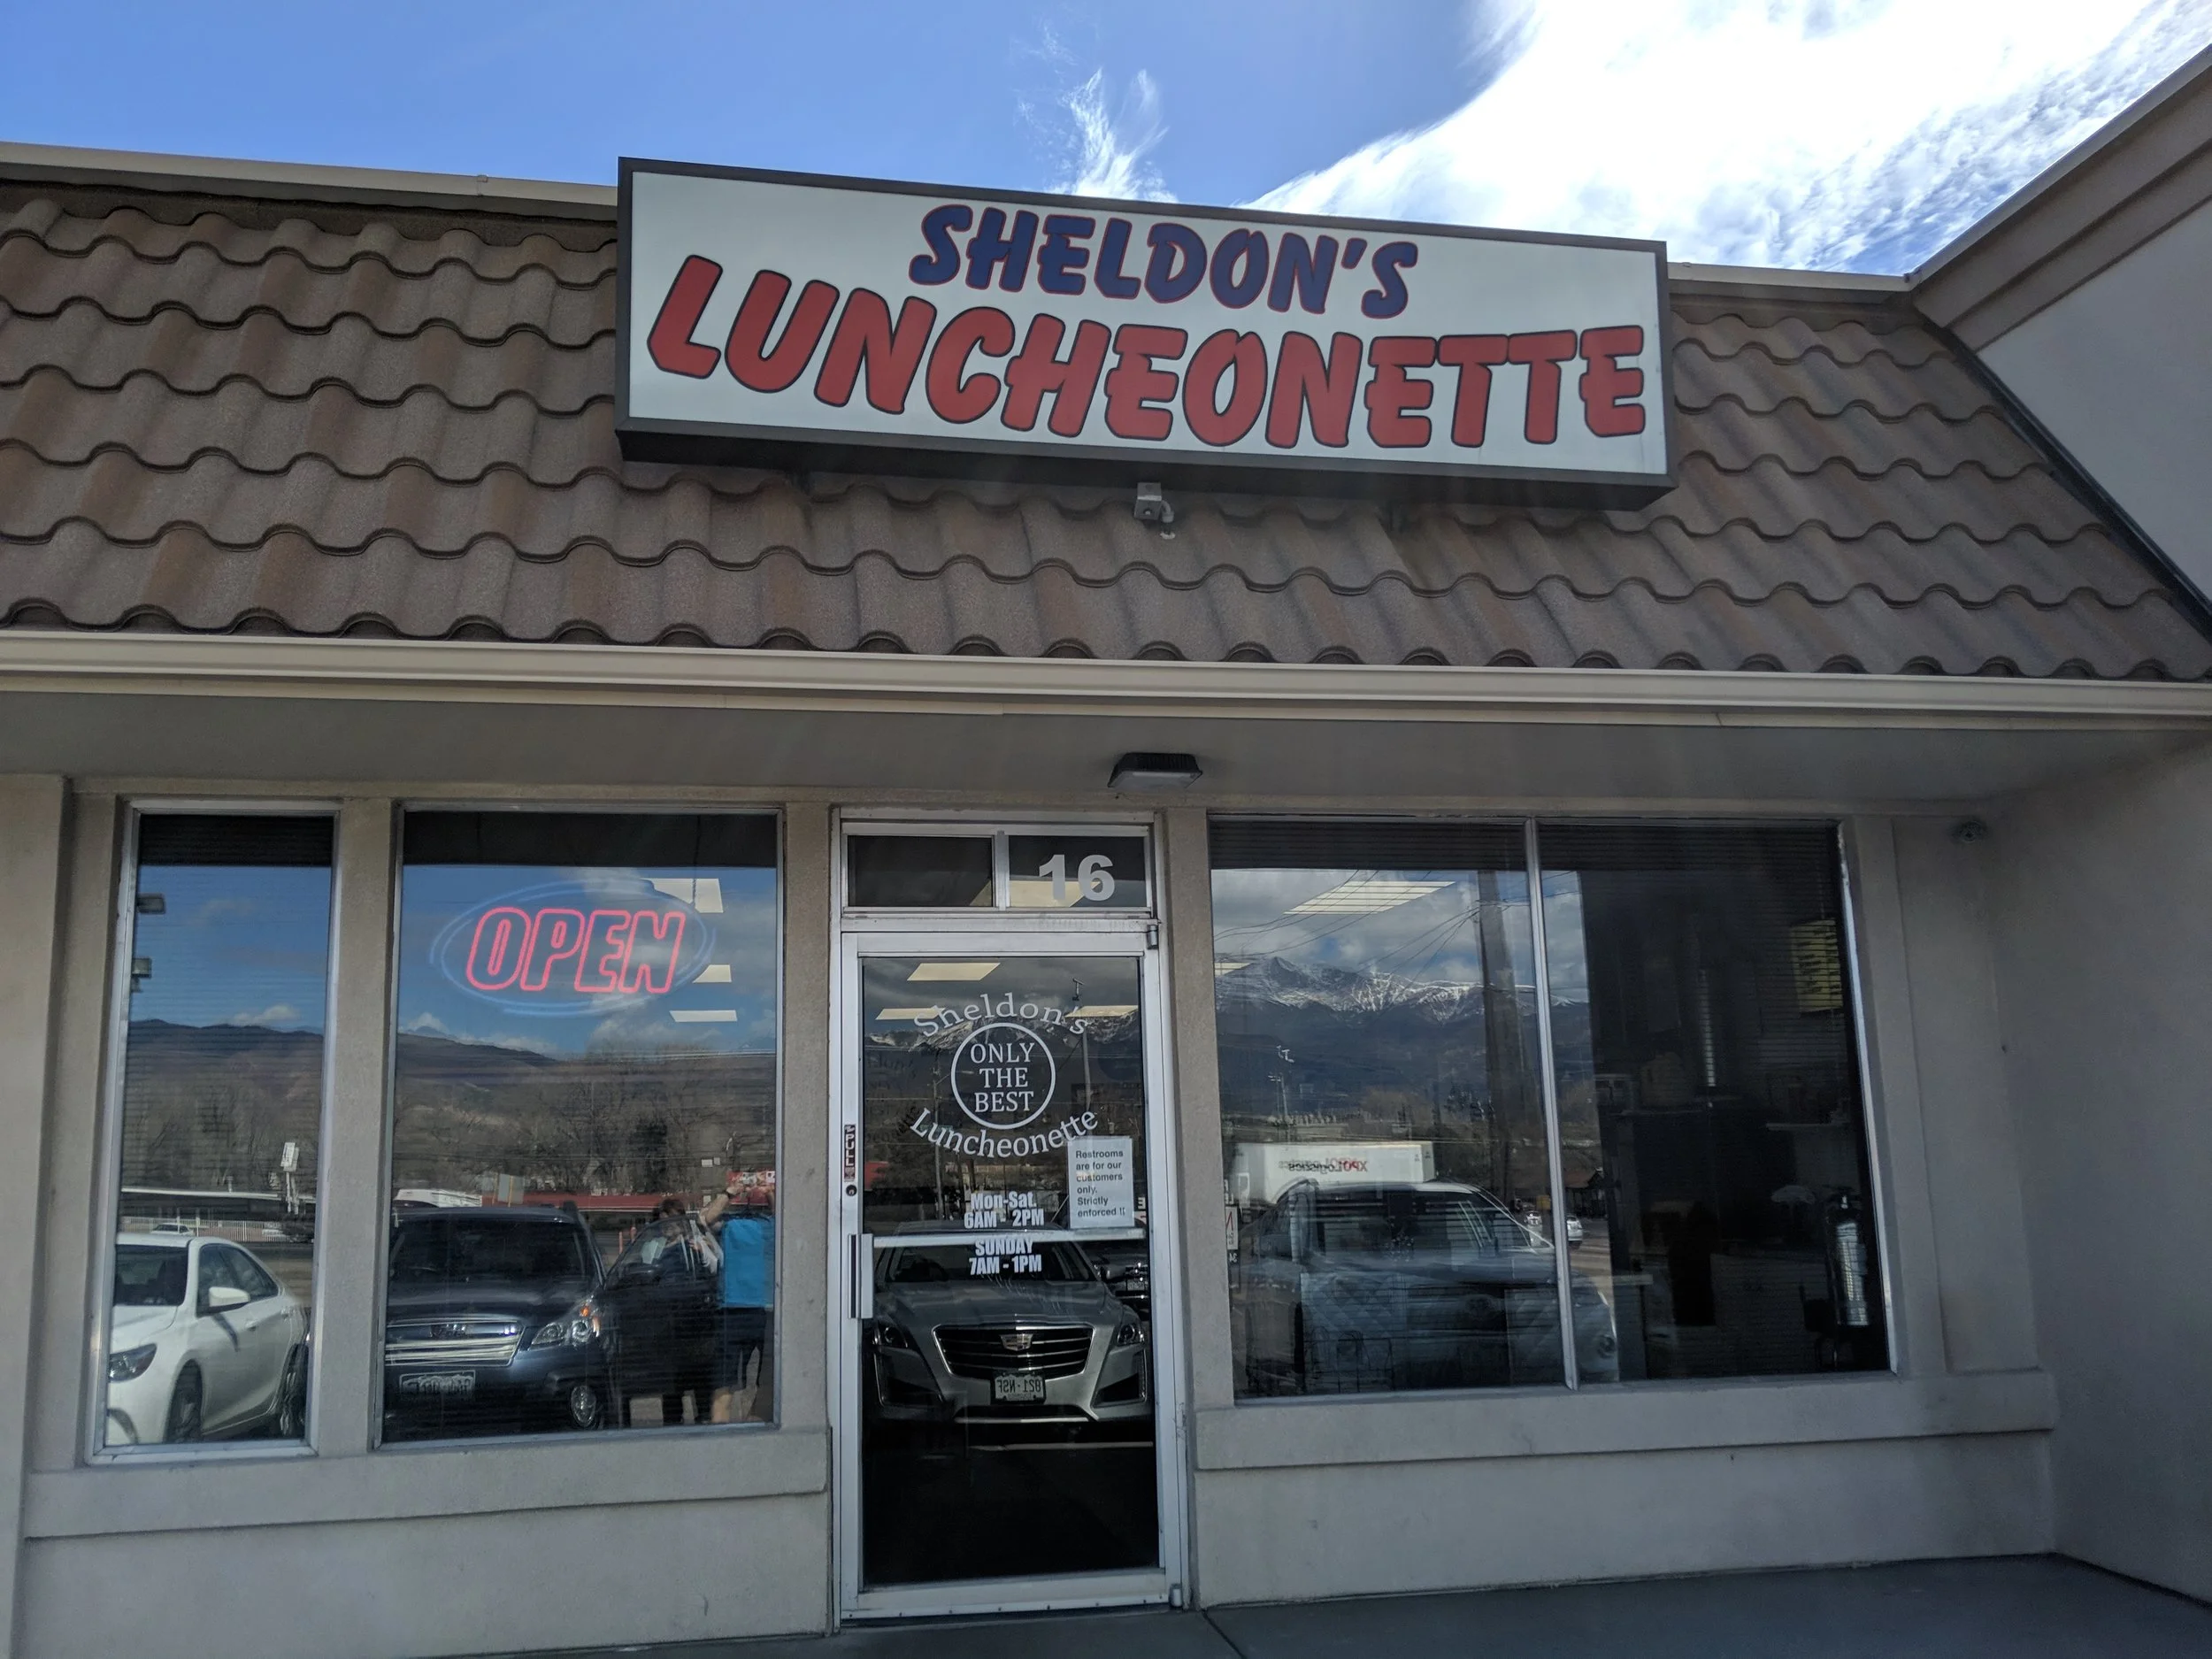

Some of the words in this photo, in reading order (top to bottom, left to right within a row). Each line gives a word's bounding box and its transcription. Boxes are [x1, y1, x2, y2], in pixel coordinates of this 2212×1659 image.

[908, 204, 1418, 319] SHELDON'S
[647, 255, 1647, 449] LUNCHEONETTE
[1039, 854, 1115, 902] 16
[465, 906, 687, 995] OPEN
[913, 993, 1088, 1038] Sheldon's
[970, 1042, 1035, 1064] ONLY
[979, 1068, 1028, 1088] THE
[974, 1091, 1034, 1113] BEST
[910, 1107, 1099, 1158] Luncheonette
[845, 1133, 855, 1166] PULL
[1075, 1150, 1124, 1159] Restrooms
[1076, 1173, 1123, 1182] customers
[971, 1191, 1037, 1210] Mon-Sat.
[1077, 1186, 1098, 1194] only.
[1077, 1196, 1109, 1206] Strictly
[964, 1210, 998, 1229] 6AM
[1011, 1209, 1044, 1227] 2PM
[1078, 1208, 1117, 1217] enforced
[975, 1239, 1033, 1256] SUNDAY
[969, 1256, 1000, 1276] 7AM
[1011, 1255, 1042, 1273] 1PM
